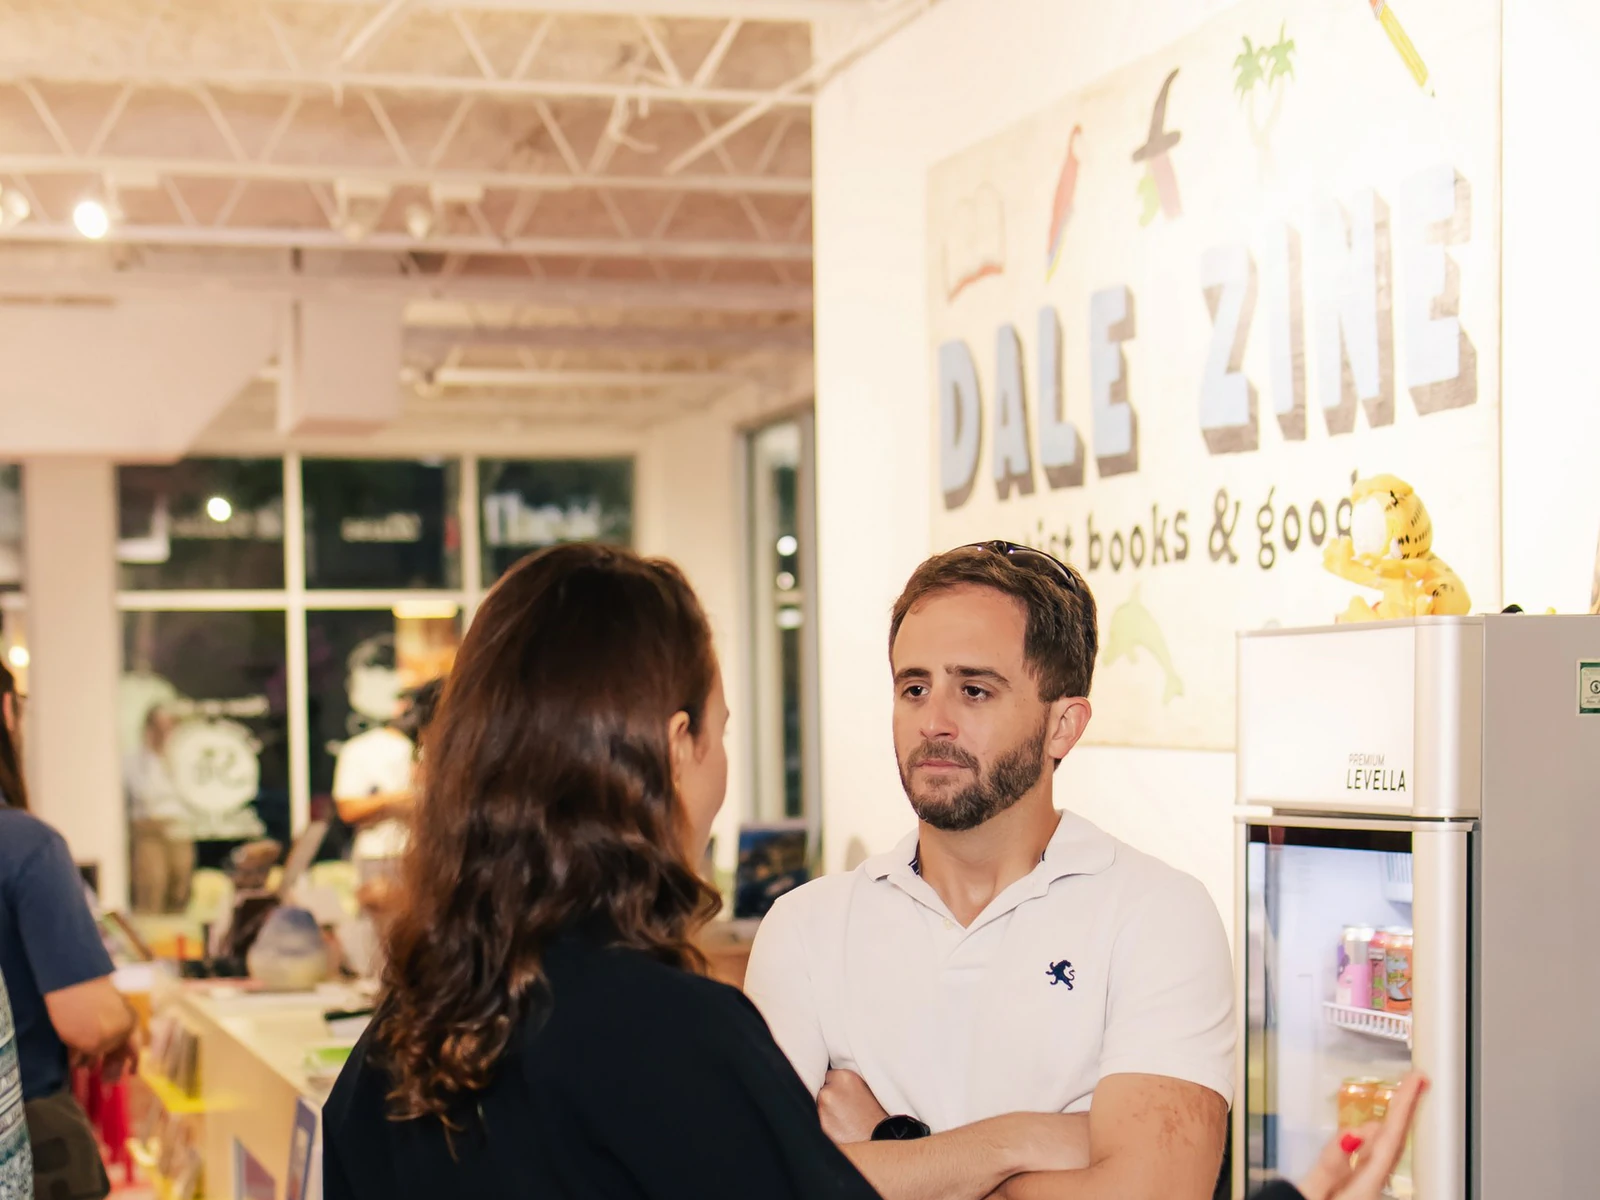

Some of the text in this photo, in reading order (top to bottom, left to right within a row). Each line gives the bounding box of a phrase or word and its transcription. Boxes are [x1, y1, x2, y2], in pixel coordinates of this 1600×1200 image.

[938, 164, 1478, 511] DALE ZINE
[1087, 502, 1190, 572] books
[1208, 487, 1241, 565] &
[1346, 769, 1406, 792] LEVELLA
[1348, 753, 1386, 766] PREMIUM
